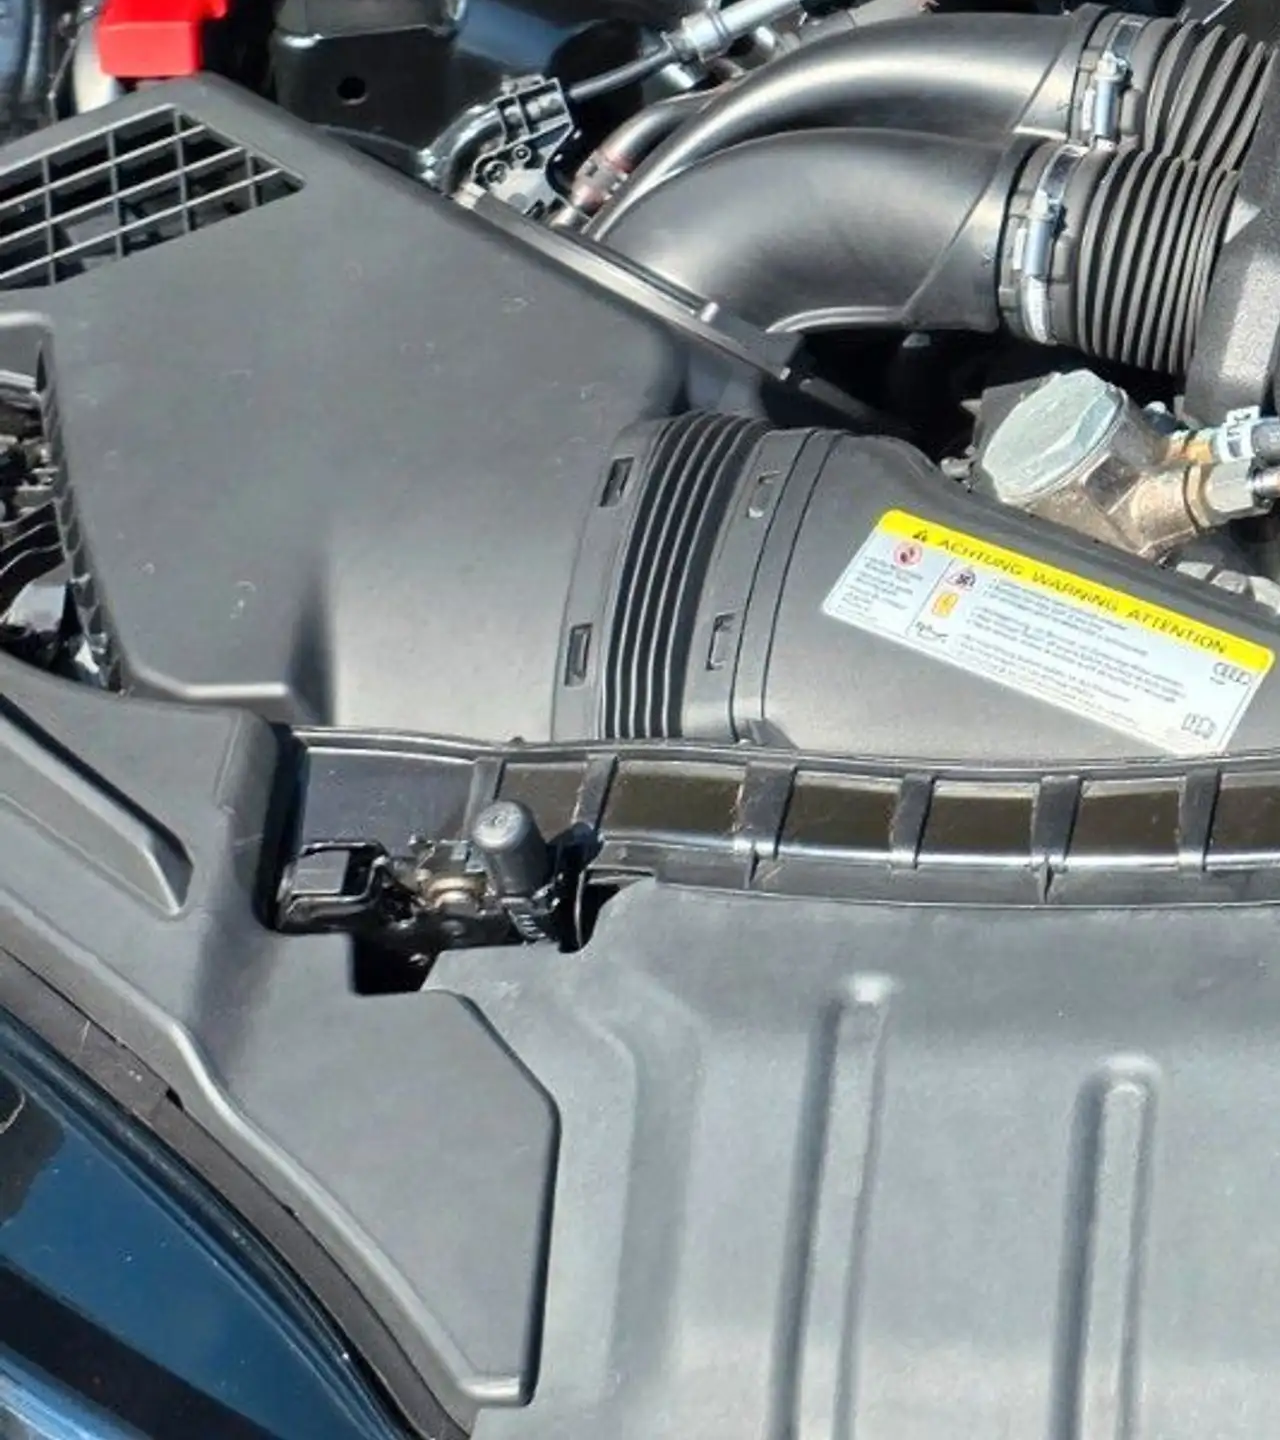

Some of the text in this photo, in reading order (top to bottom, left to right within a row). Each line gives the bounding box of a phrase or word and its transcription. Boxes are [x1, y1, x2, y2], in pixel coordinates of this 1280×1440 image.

[940, 539, 1023, 576] ACHTUNG
[1031, 570, 1120, 613] WARNING
[1127, 609, 1228, 655] ATTENTION
